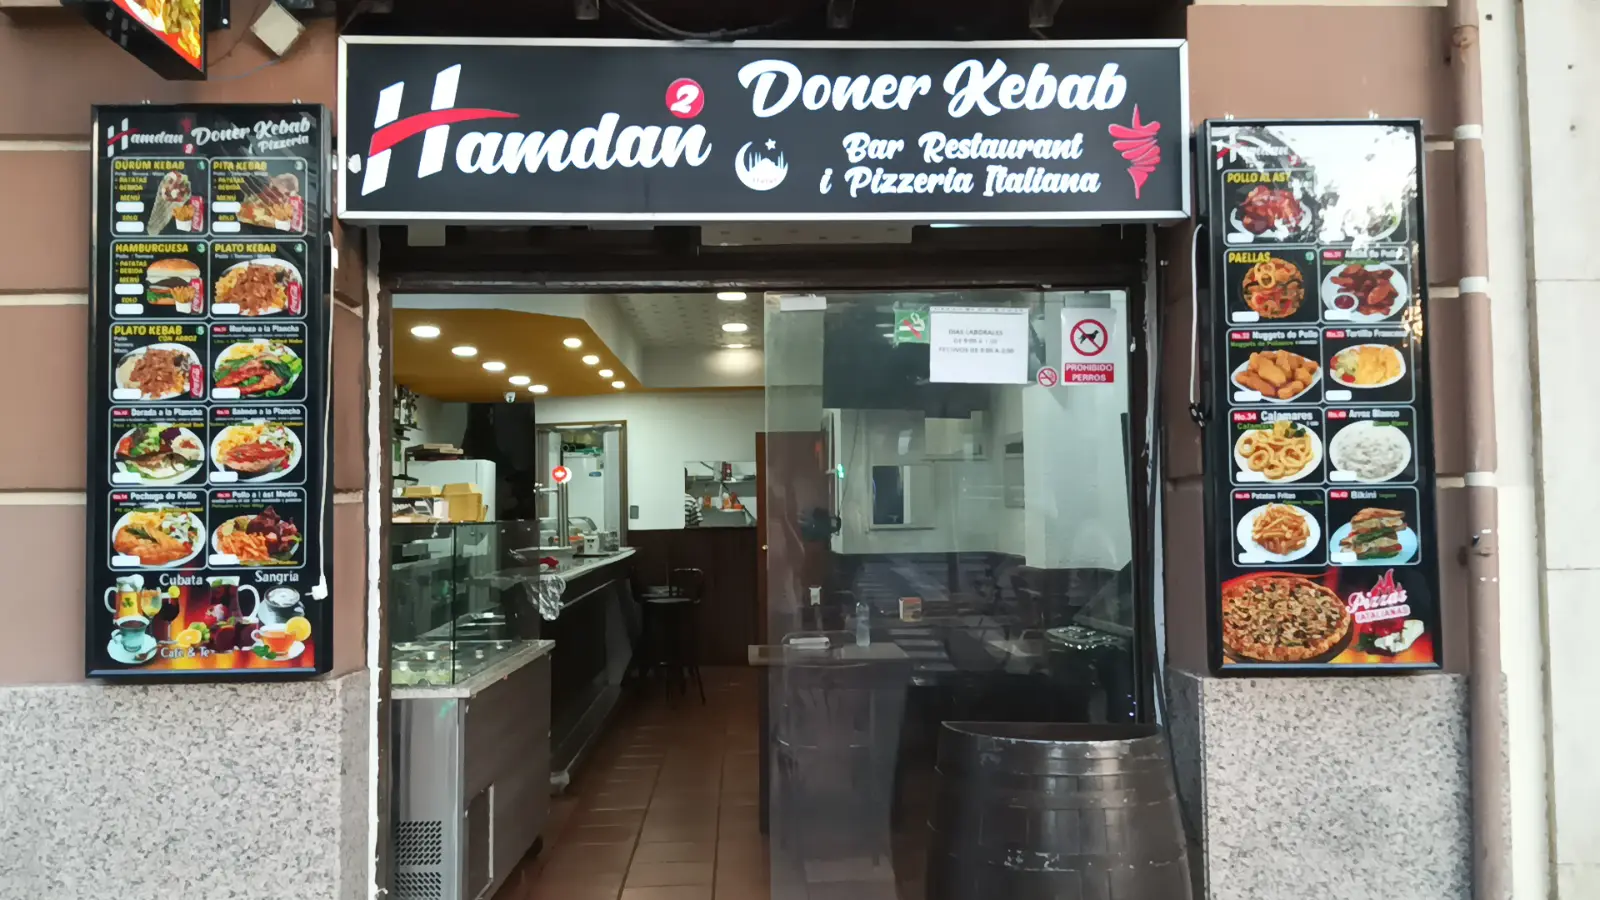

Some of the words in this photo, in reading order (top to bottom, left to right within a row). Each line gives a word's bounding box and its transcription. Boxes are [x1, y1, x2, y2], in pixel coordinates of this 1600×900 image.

[738, 59, 932, 118] Doner
[943, 58, 1128, 118] Kebab
[191, 126, 250, 146] Doner
[253, 116, 310, 139] Kebab
[361, 64, 712, 196] Hamdan
[671, 84, 699, 113] 2
[107, 118, 184, 157] Hamdan
[258, 135, 309, 153] Pizzeria
[842, 131, 904, 161] Bar
[918, 132, 1084, 163] Restaurant
[153, 161, 186, 170] KEBAB
[213, 161, 234, 170] PITA
[844, 166, 974, 198] Pizzeria
[983, 165, 1102, 197] Italiana
[1227, 172, 1258, 183] POLLO
[115, 243, 189, 253] HAMBURGUESA
[215, 243, 244, 253] PLATO
[246, 243, 277, 253] KEBAB
[1228, 251, 1271, 264] PAELLAS
[114, 325, 146, 335] PLATO
[149, 325, 182, 335] KEBAB
[1065, 363, 1113, 372] PROHIBIDO
[1072, 373, 1107, 381] PERROS
[1260, 411, 1313, 421] Calamares
[159, 573, 203, 586] Cubata
[254, 570, 299, 585] Sangria
